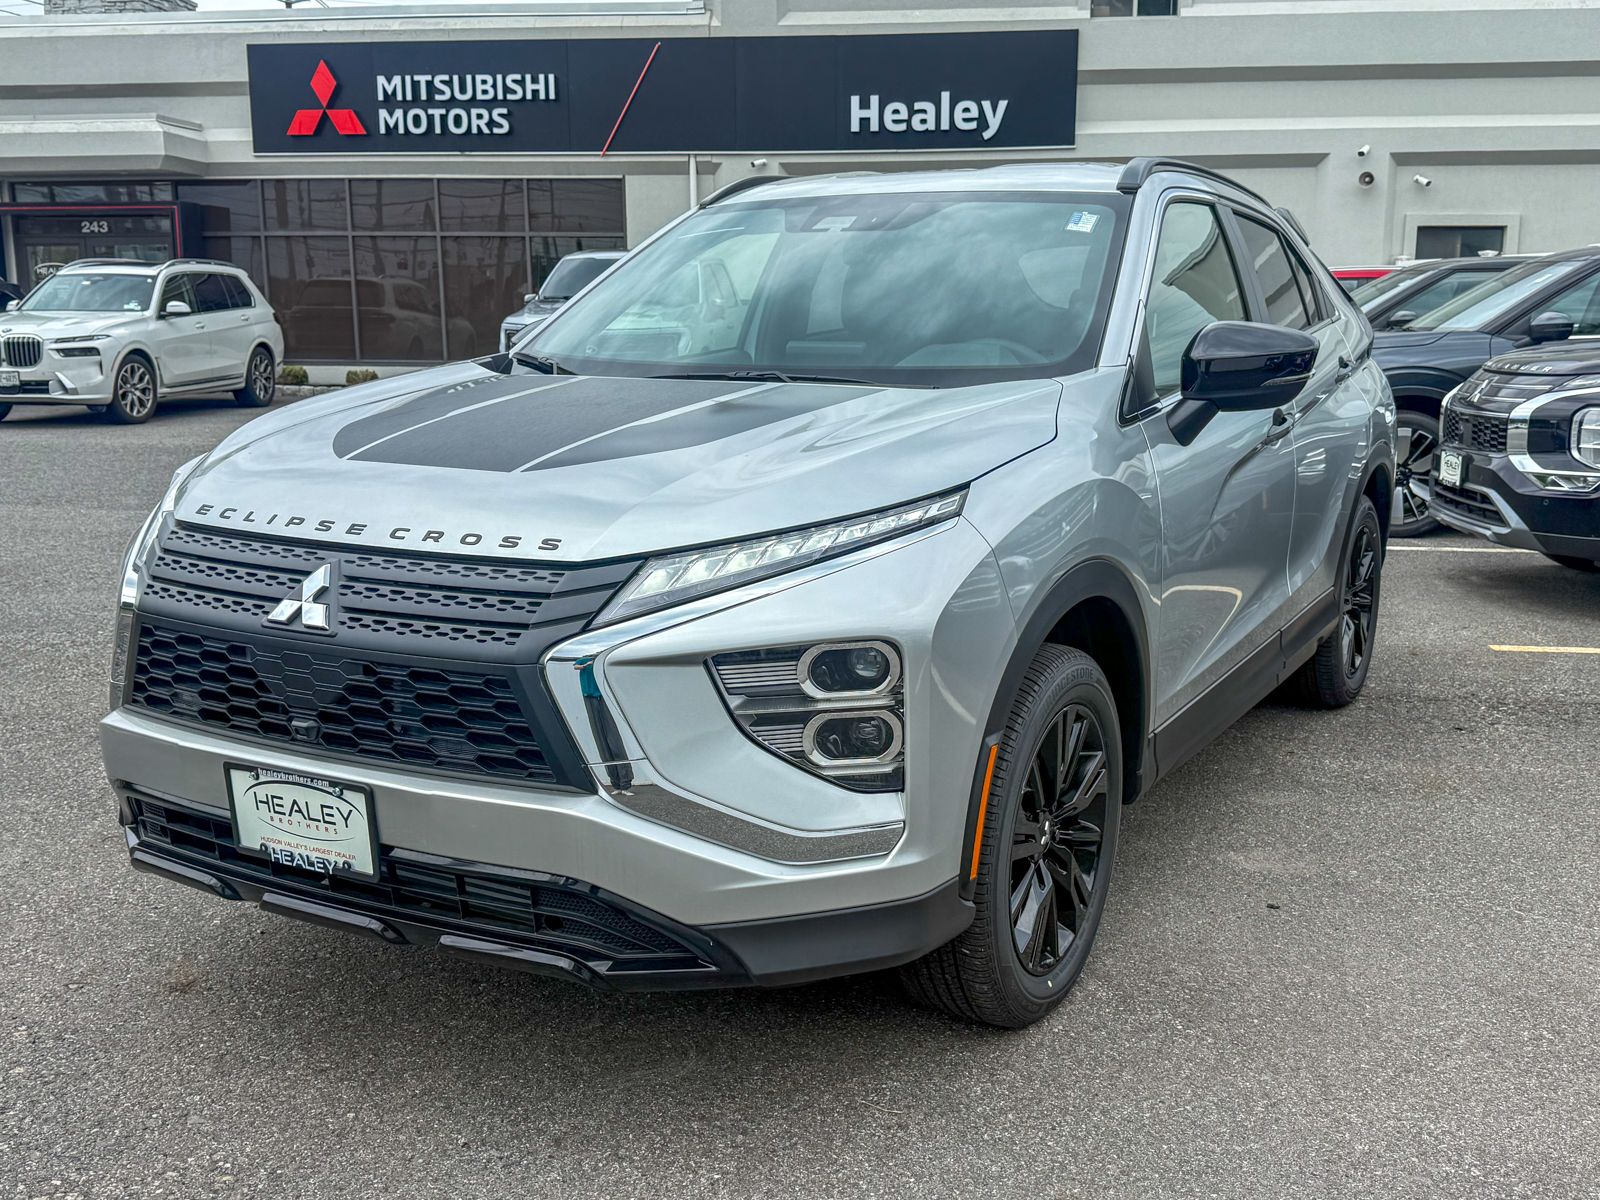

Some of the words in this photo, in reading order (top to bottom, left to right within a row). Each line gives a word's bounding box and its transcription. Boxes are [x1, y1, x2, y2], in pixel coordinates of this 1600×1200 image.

[376, 74, 556, 101] MITSUBISHI
[378, 108, 510, 135] MOTORS
[850, 90, 1009, 141] Healey
[81, 221, 109, 233] 243
[195, 503, 367, 535] ECLIPSE
[389, 527, 562, 551] CROSS
[257, 768, 330, 787] healeybrothers.com
[253, 791, 353, 829] HEALEY
[269, 815, 338, 835] BROTHERS
[260, 836, 283, 846] HUDSON
[308, 845, 333, 856] LARGEST
[270, 847, 336, 875] HEALEY
